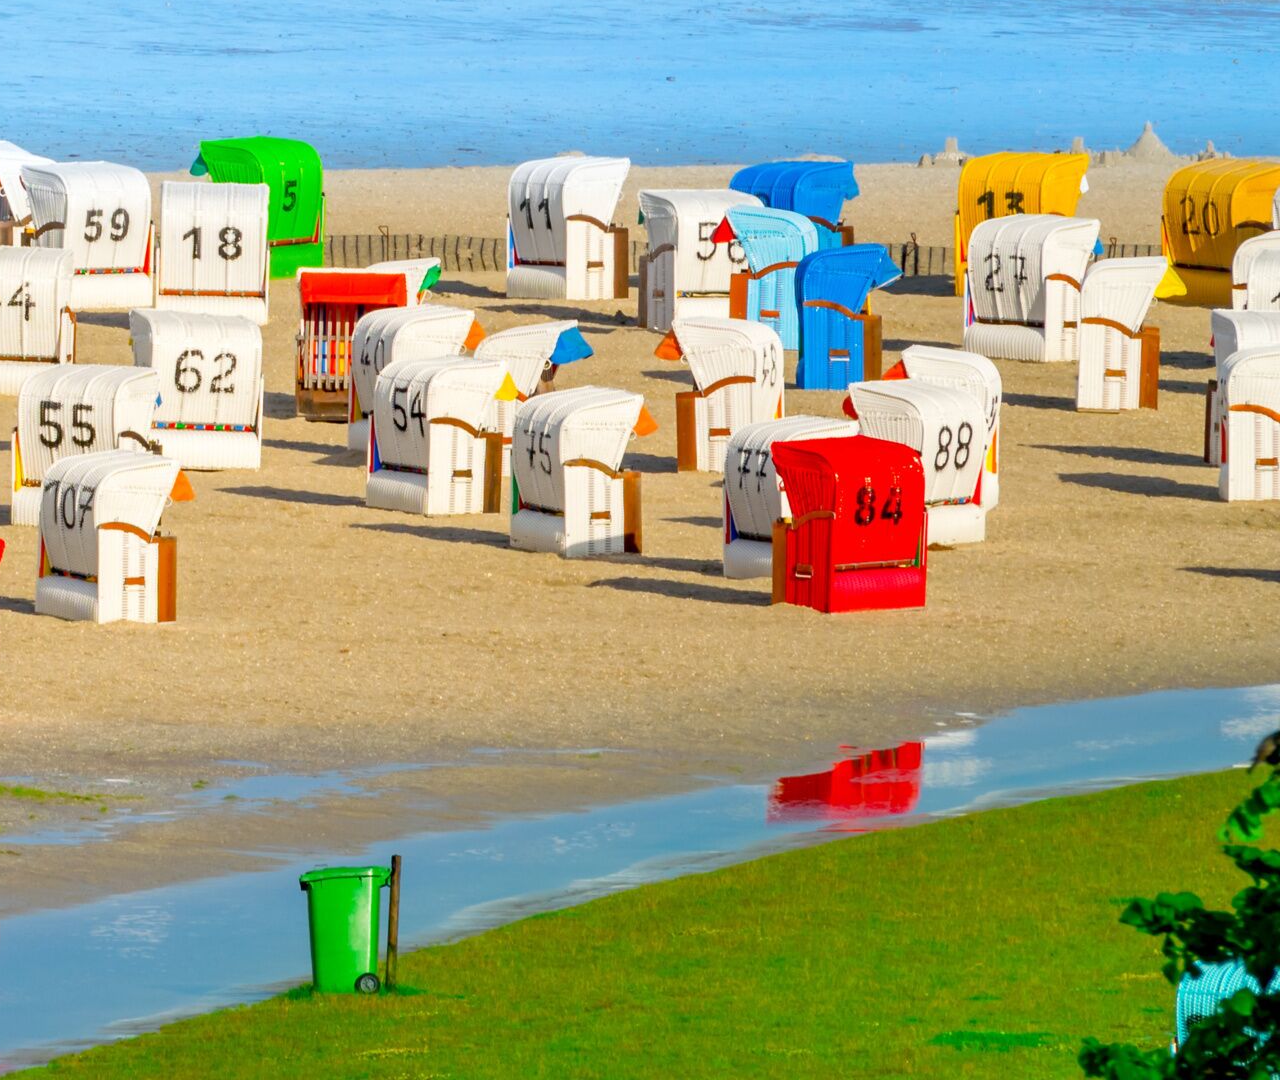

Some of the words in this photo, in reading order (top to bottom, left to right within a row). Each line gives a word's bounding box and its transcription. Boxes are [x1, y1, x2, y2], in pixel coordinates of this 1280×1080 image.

[282, 180, 298, 212] 5
[520, 198, 552, 230] 11
[977, 189, 1025, 219] 13
[1181, 195, 1220, 238] 20
[83, 208, 131, 242] 59
[182, 226, 243, 261] 18
[984, 252, 1028, 293] 27
[174, 350, 238, 394] 62
[40, 400, 97, 448] 55
[393, 384, 426, 437] 54
[523, 429, 552, 475] 75
[934, 421, 973, 472] 88
[43, 478, 94, 530] 107
[854, 486, 902, 526] 84
